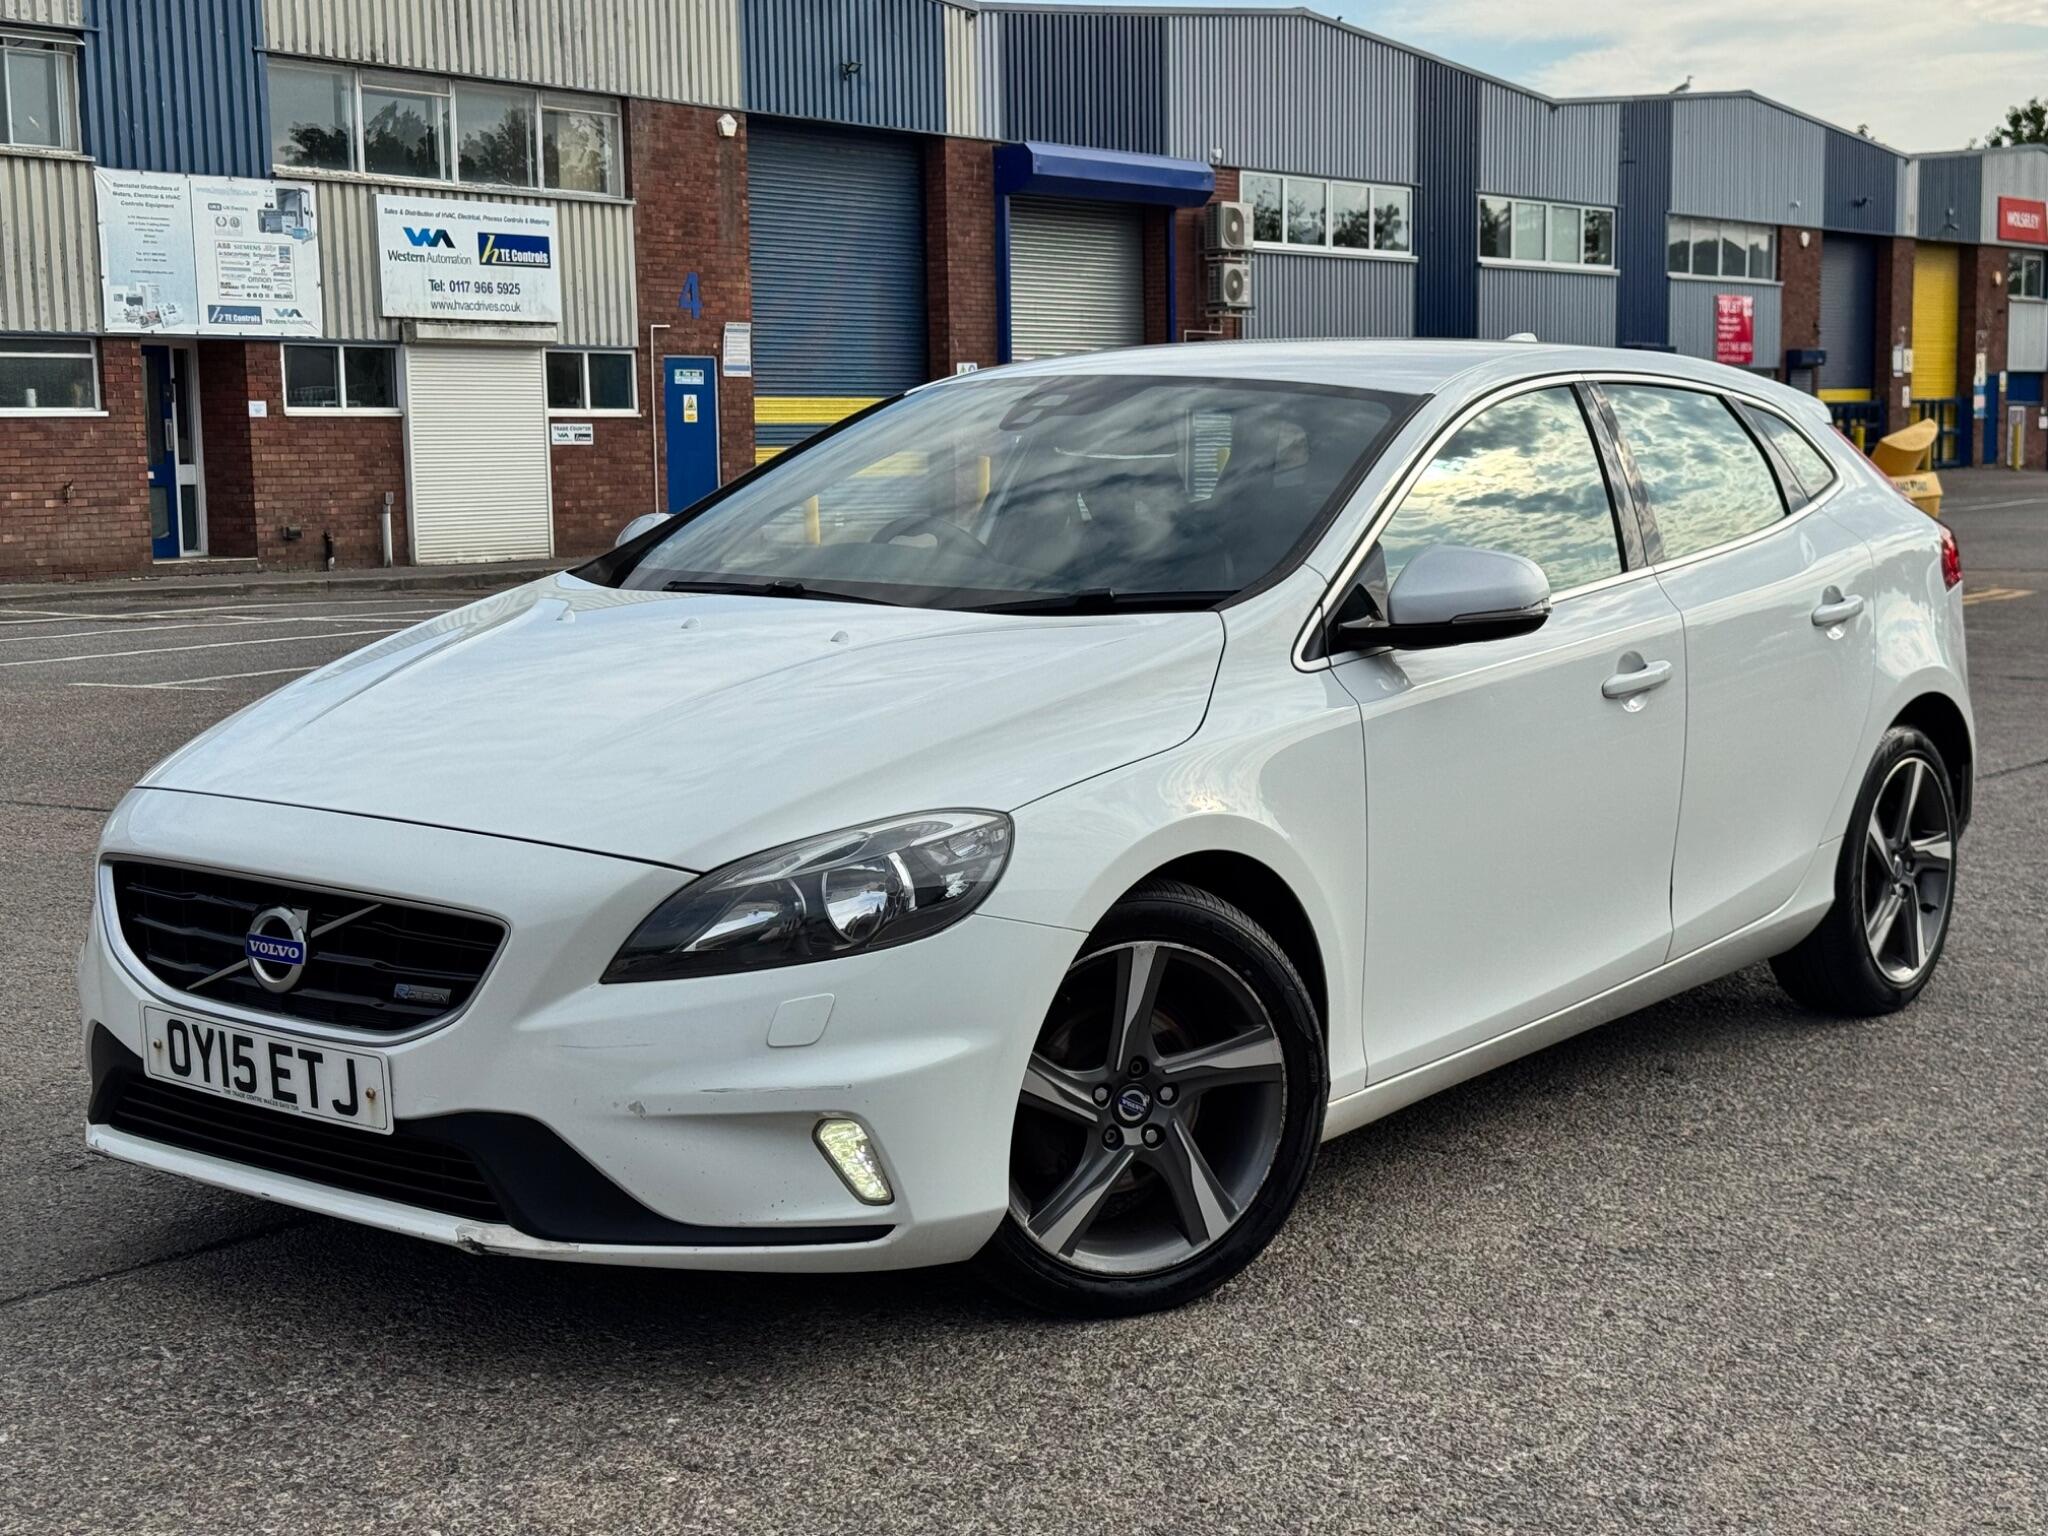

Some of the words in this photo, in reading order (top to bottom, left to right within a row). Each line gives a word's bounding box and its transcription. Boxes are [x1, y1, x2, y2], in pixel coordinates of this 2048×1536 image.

[384, 207, 398, 215] Sales
[405, 209, 434, 217] Distribution
[504, 216, 523, 224] Controls
[388, 249, 425, 263] Western
[426, 252, 472, 265] Automation
[500, 248, 511, 262] TE
[511, 249, 548, 264] Controls
[428, 279, 445, 292] Tel:
[449, 280, 470, 293] 0117
[474, 281, 494, 294] 966
[496, 282, 520, 295] 5925
[678, 272, 704, 320] 4
[430, 299, 522, 313] www.hvacdrives.co.uk
[233, 314, 260, 322] Controls
[249, 940, 299, 959] VOLVO
[167, 1018, 257, 1094] OY15
[268, 1042, 359, 1117] ETJ
[246, 1094, 262, 1103] CENTRE
